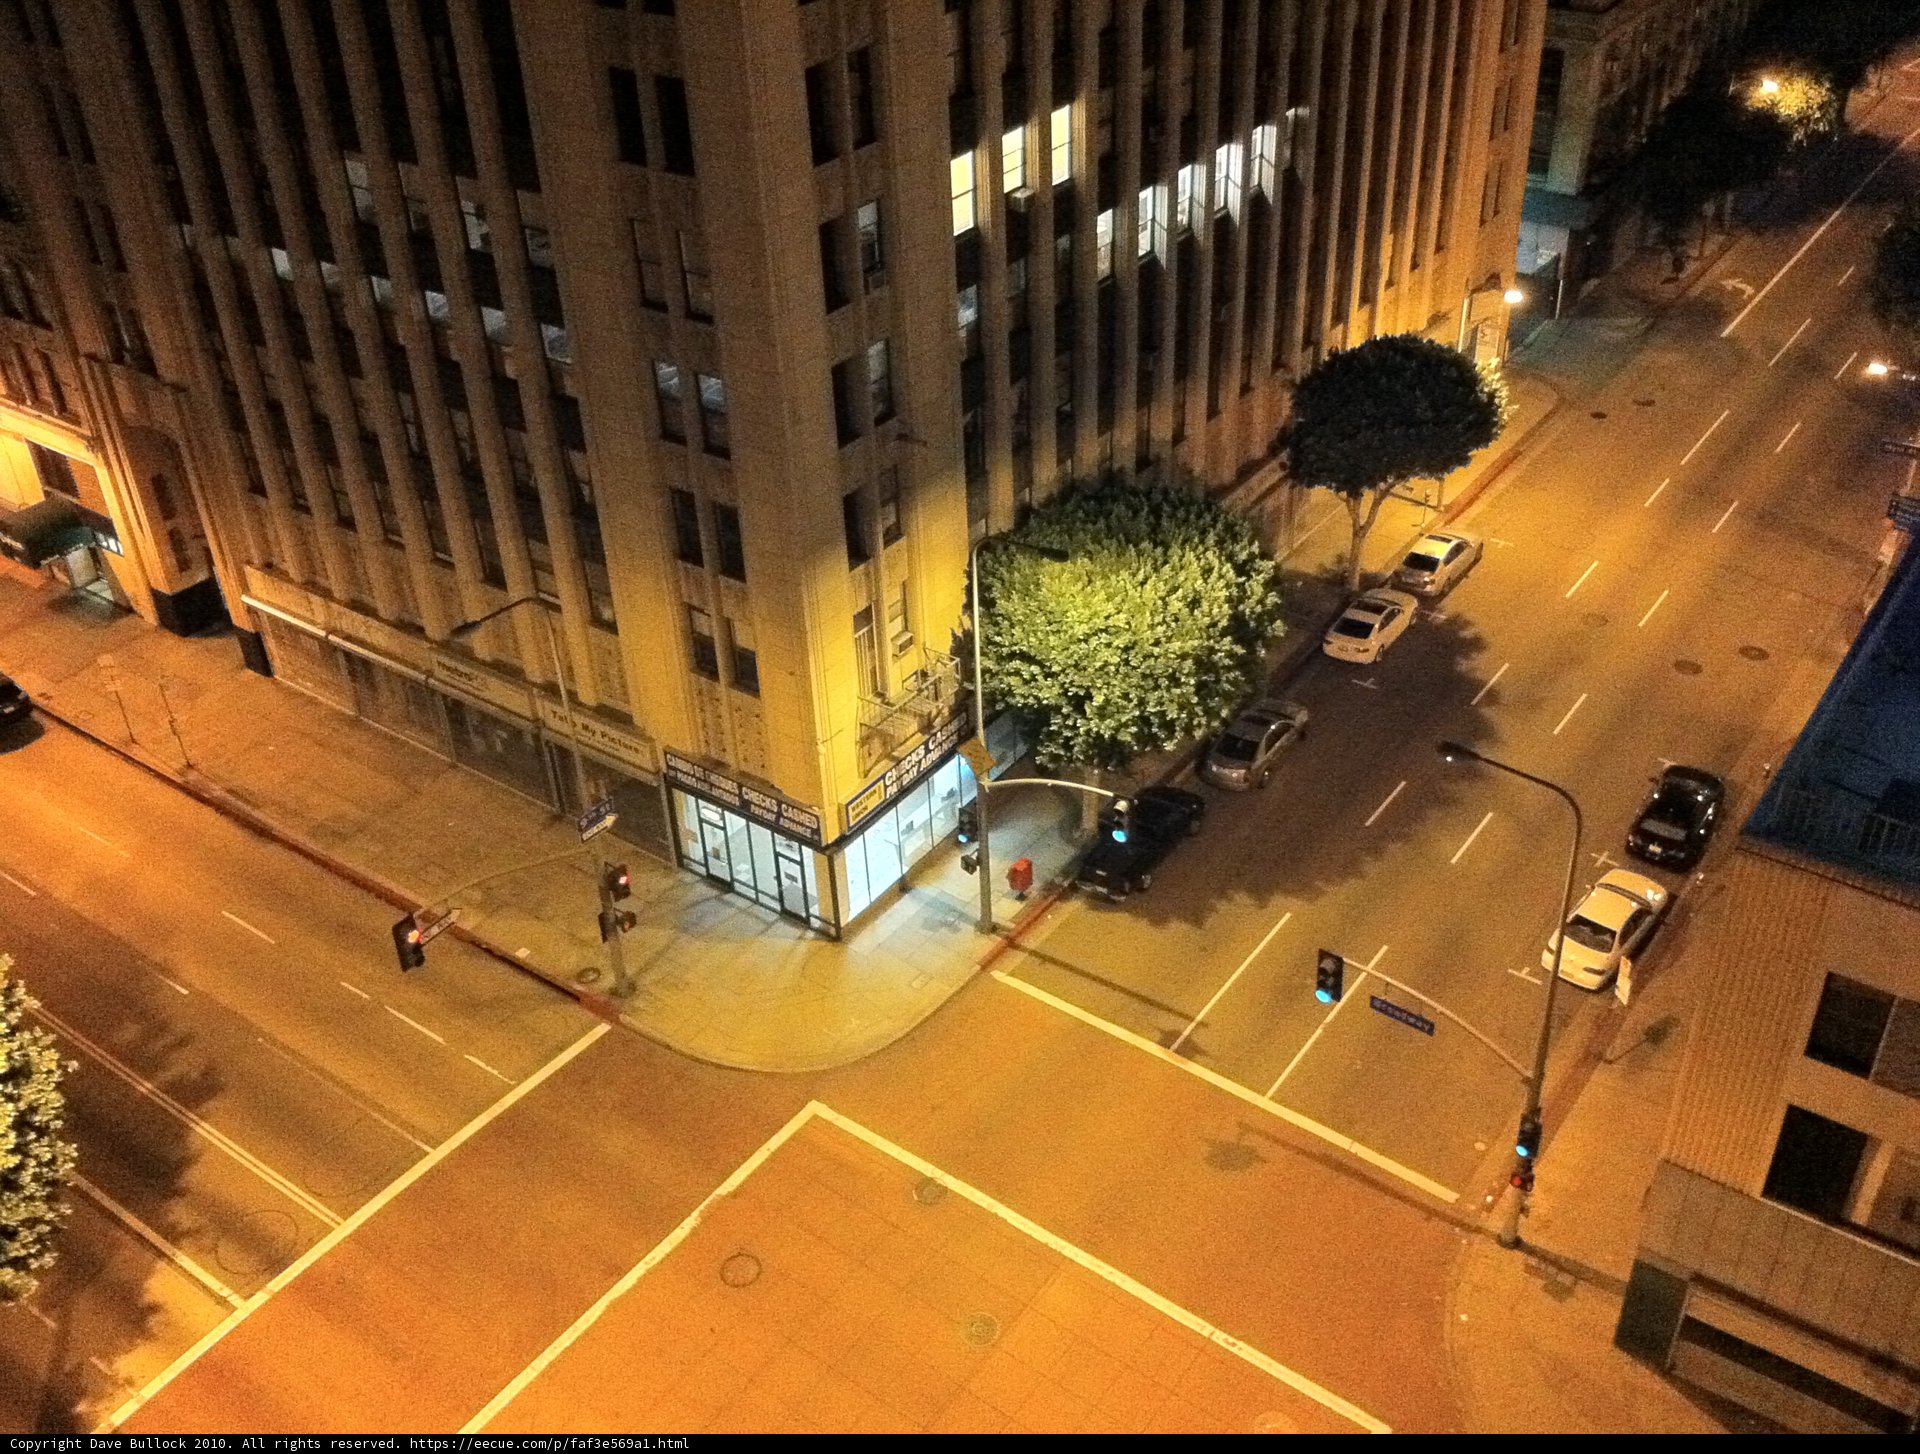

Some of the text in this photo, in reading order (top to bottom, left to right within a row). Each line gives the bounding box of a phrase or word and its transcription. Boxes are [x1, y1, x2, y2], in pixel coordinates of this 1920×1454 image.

[582, 722, 596, 737] My
[601, 731, 639, 754] Picture
[885, 712, 967, 786] CHECKS CASHED
[920, 732, 959, 771] ADVANCE
[741, 786, 778, 813] CHECKS
[781, 803, 818, 830] CASHED
[851, 789, 877, 813] WESTERN
[779, 817, 812, 838] ADVANCE
